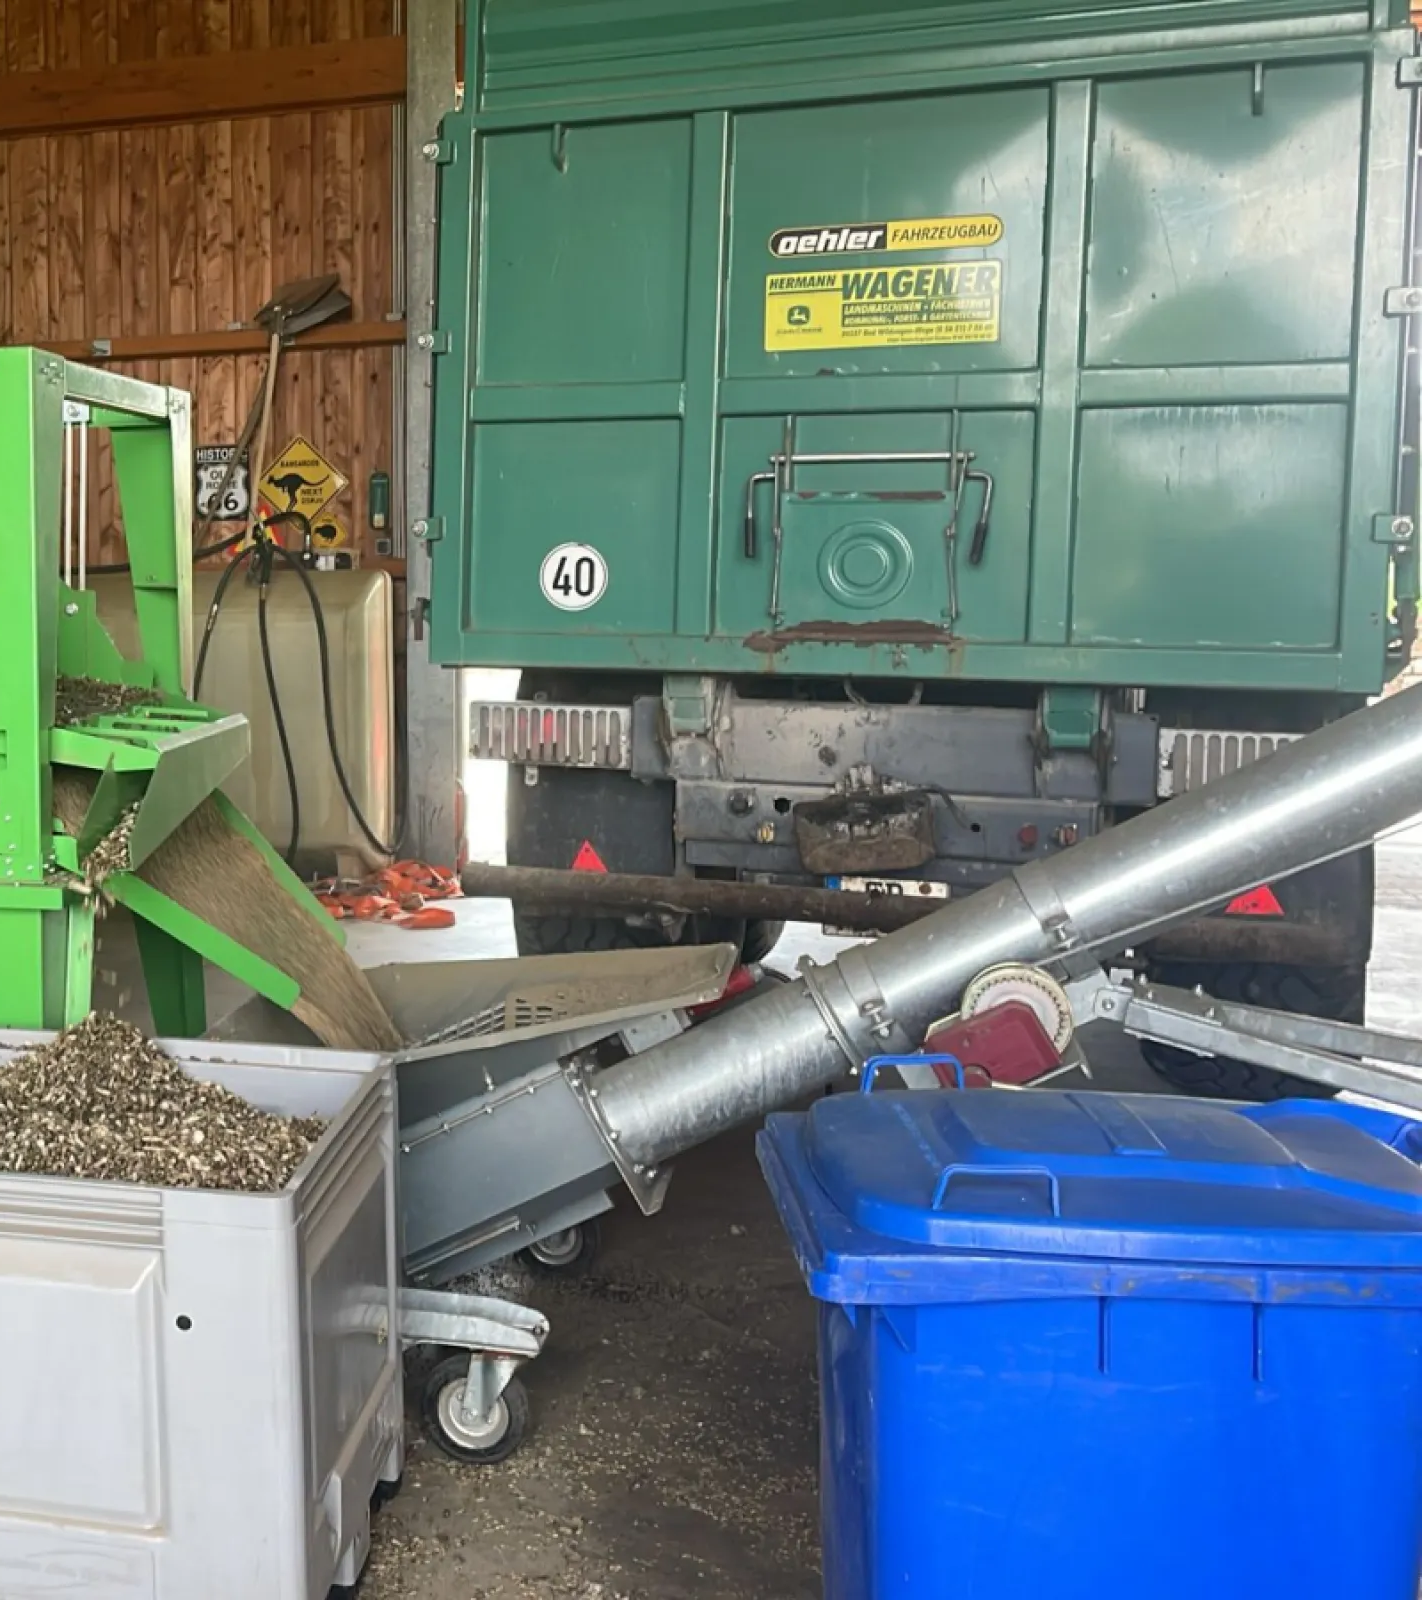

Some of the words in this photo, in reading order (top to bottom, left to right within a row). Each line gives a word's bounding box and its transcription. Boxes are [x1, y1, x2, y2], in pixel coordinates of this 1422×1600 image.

[778, 228, 884, 255] oehler
[891, 223, 999, 243] FAHRZEUGBAU
[769, 274, 836, 290] HERMANN
[842, 266, 998, 300] WAGENER
[301, 488, 323, 496] NEXT
[552, 555, 596, 597] 40
